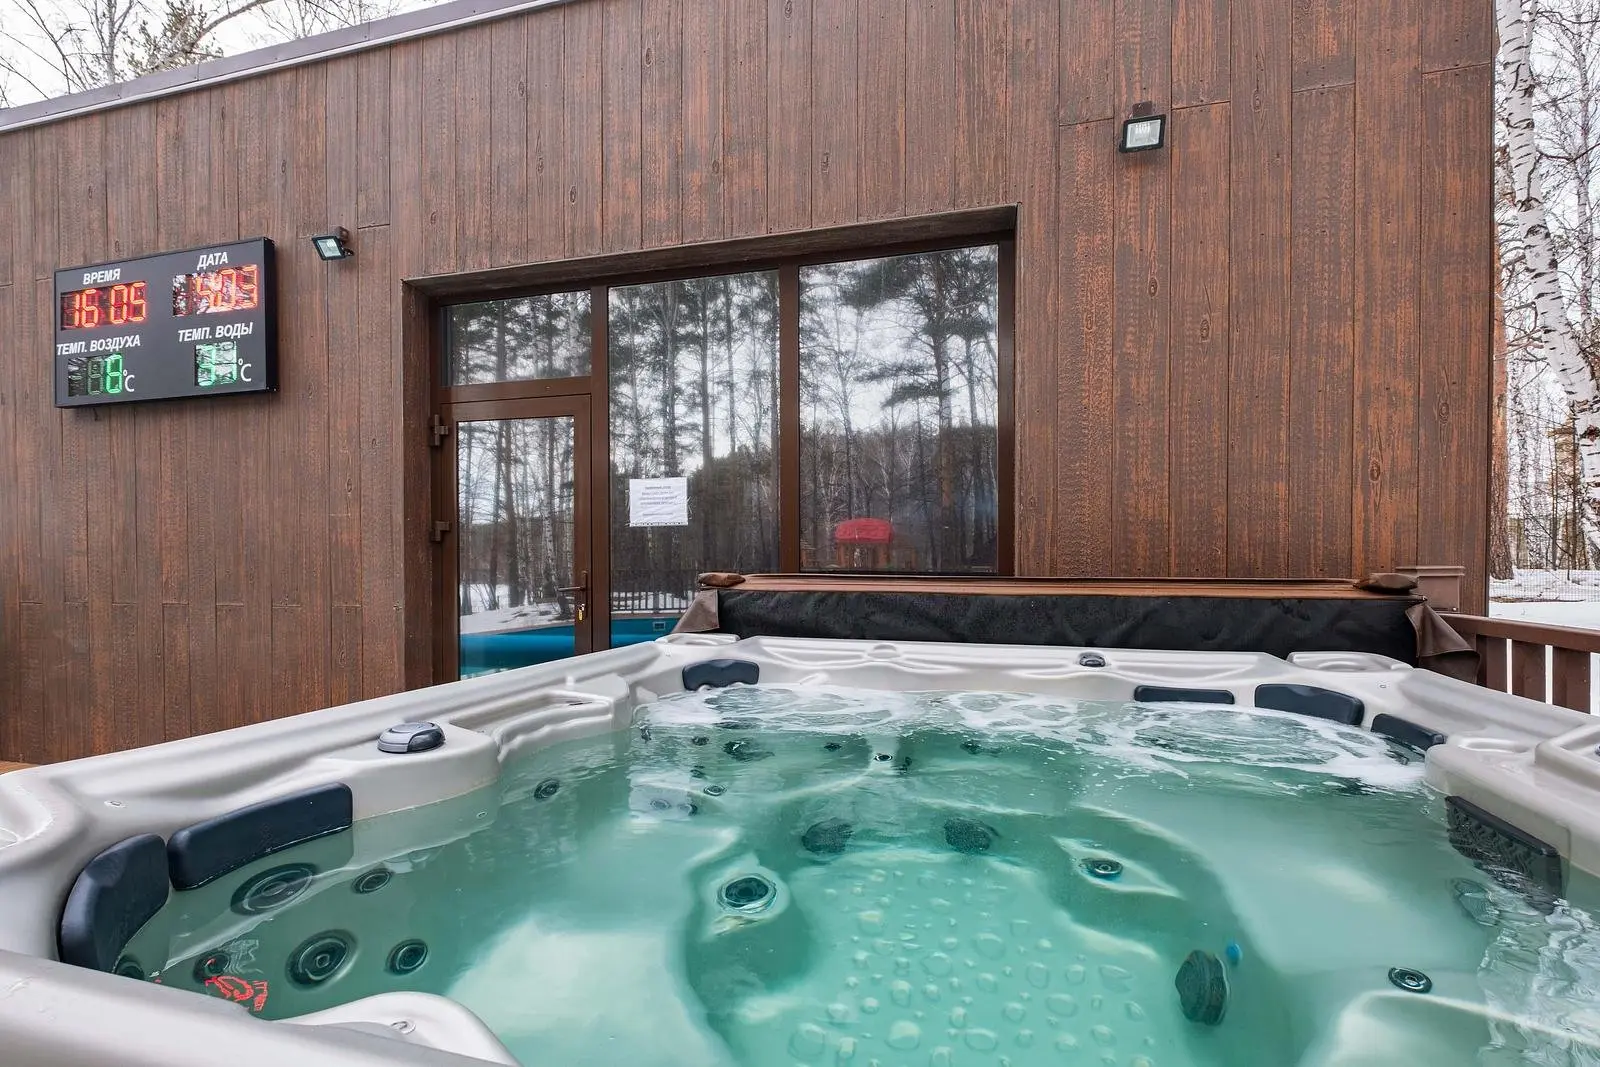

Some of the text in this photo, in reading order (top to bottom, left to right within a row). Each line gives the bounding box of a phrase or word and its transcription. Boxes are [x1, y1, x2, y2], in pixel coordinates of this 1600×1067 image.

[197, 251, 228, 270] ДАТА
[83, 268, 121, 285] ВРЕМЯ
[177, 321, 253, 343] ТЕМП. ВОДЫ
[56, 334, 141, 356] ТЕМП. ВОЗДУХА
